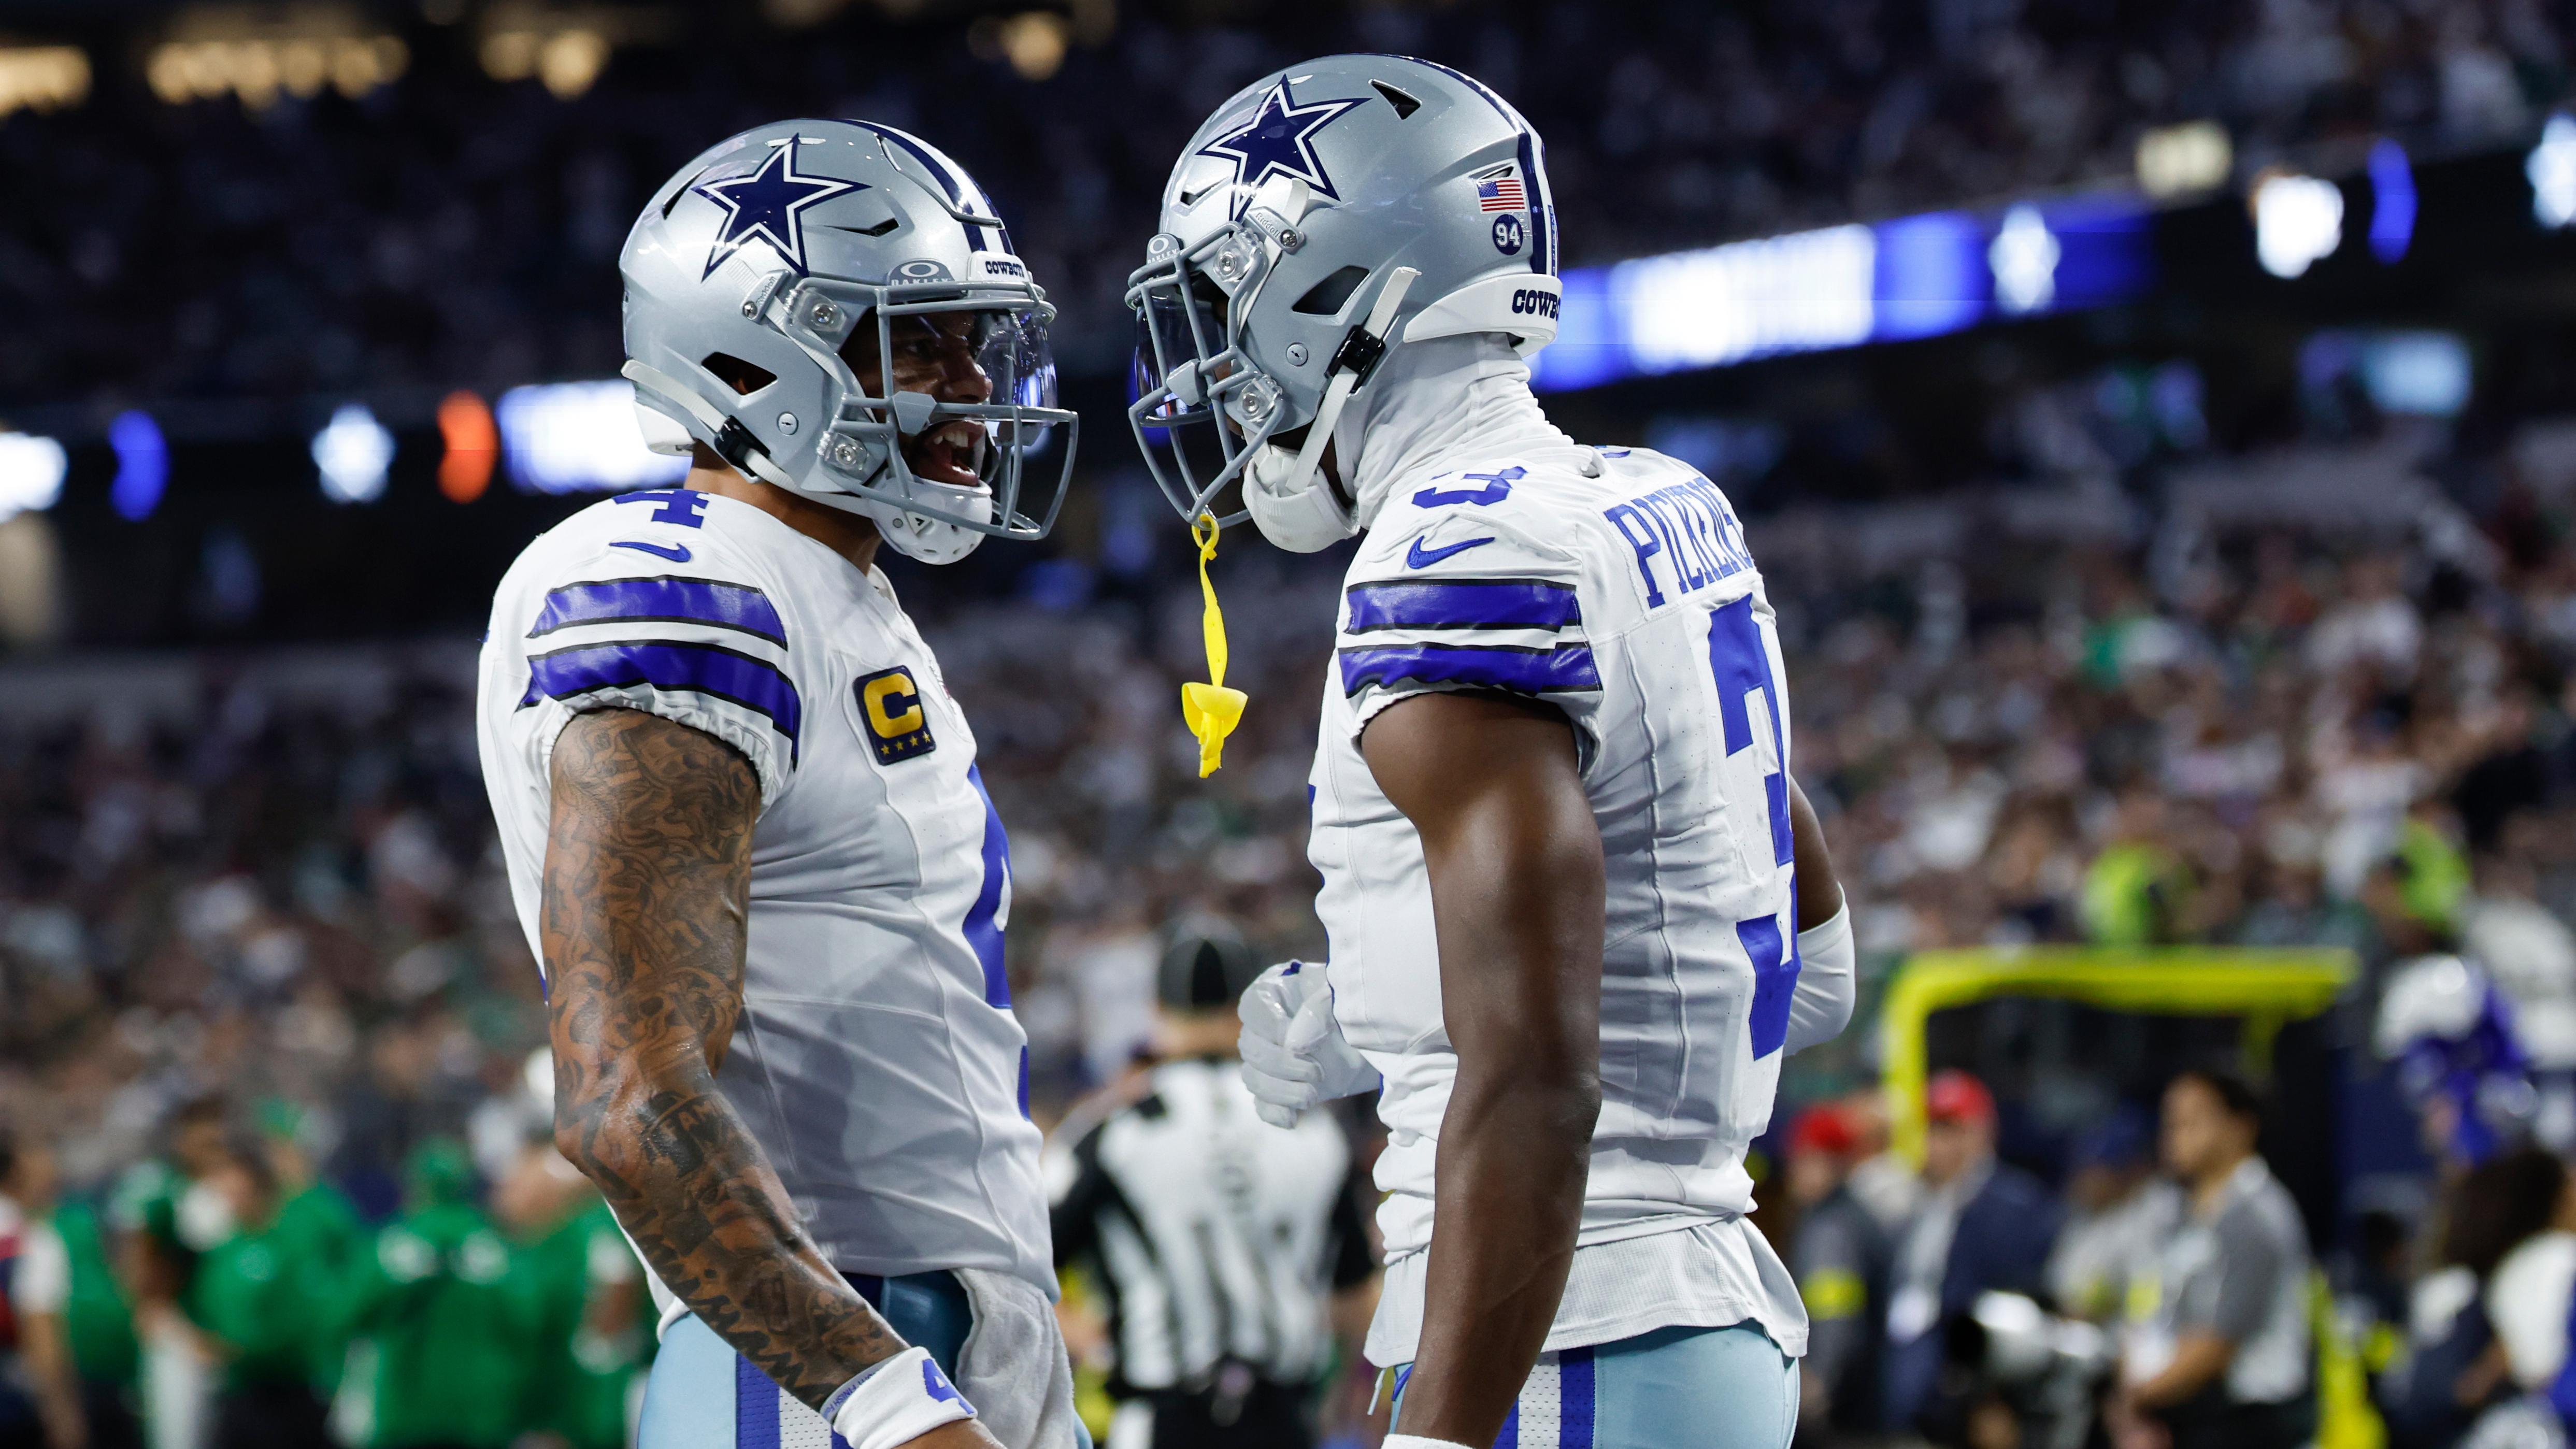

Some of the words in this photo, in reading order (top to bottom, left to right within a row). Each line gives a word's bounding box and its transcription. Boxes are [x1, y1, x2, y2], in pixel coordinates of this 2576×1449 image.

[1495, 222, 1521, 247] 94
[1411, 466, 1529, 509] 3
[864, 672, 923, 739] C
[1708, 592, 1802, 1061] 3
